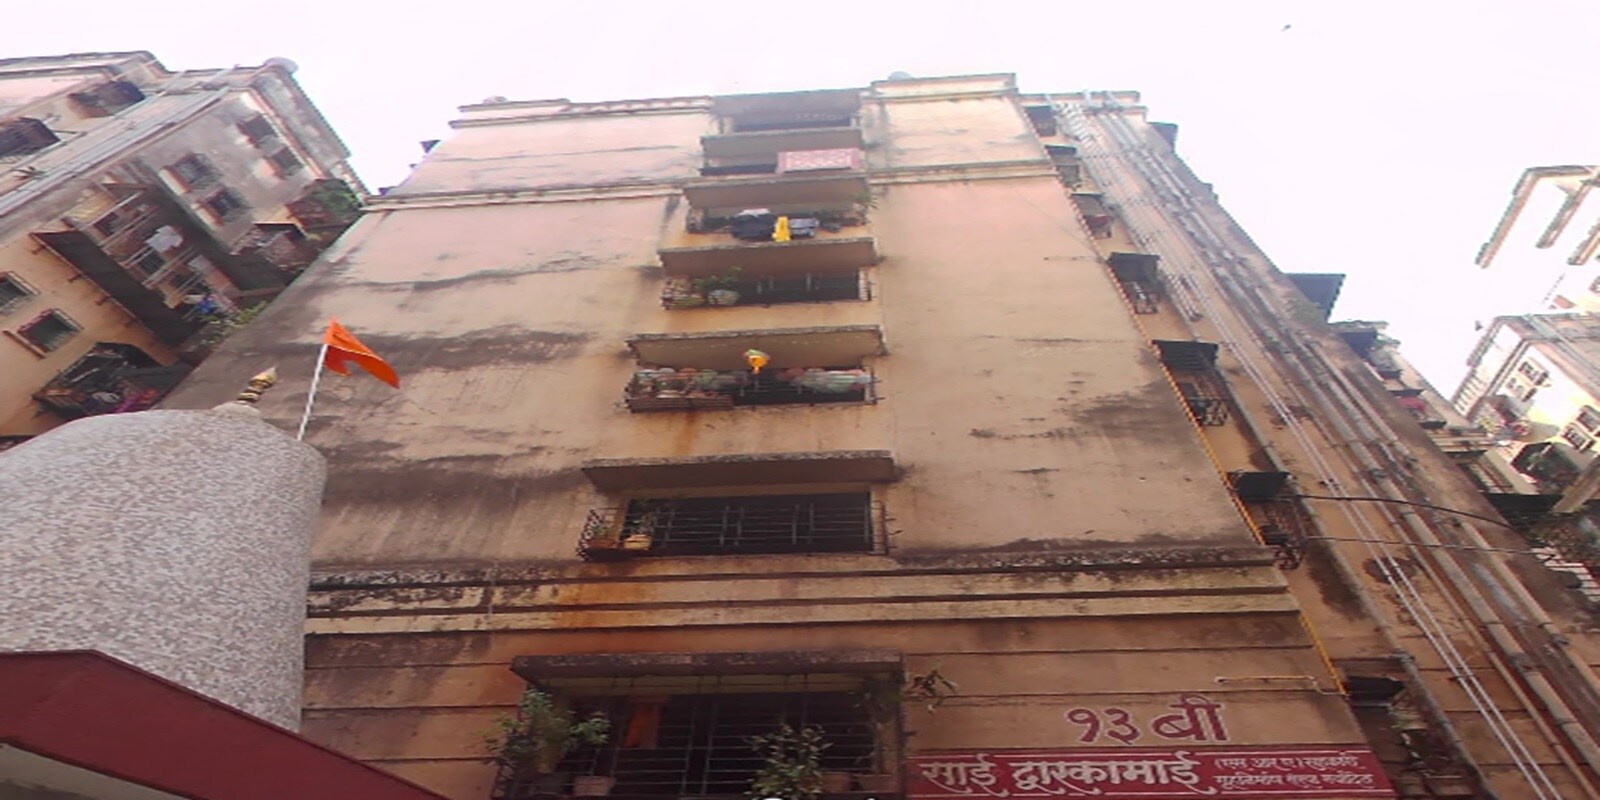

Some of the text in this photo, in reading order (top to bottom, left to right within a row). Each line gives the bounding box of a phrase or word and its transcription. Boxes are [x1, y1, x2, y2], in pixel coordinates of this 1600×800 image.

[1065, 693, 1230, 745] १३ बी
[920, 750, 1218, 798] साई द्वारकामाई
